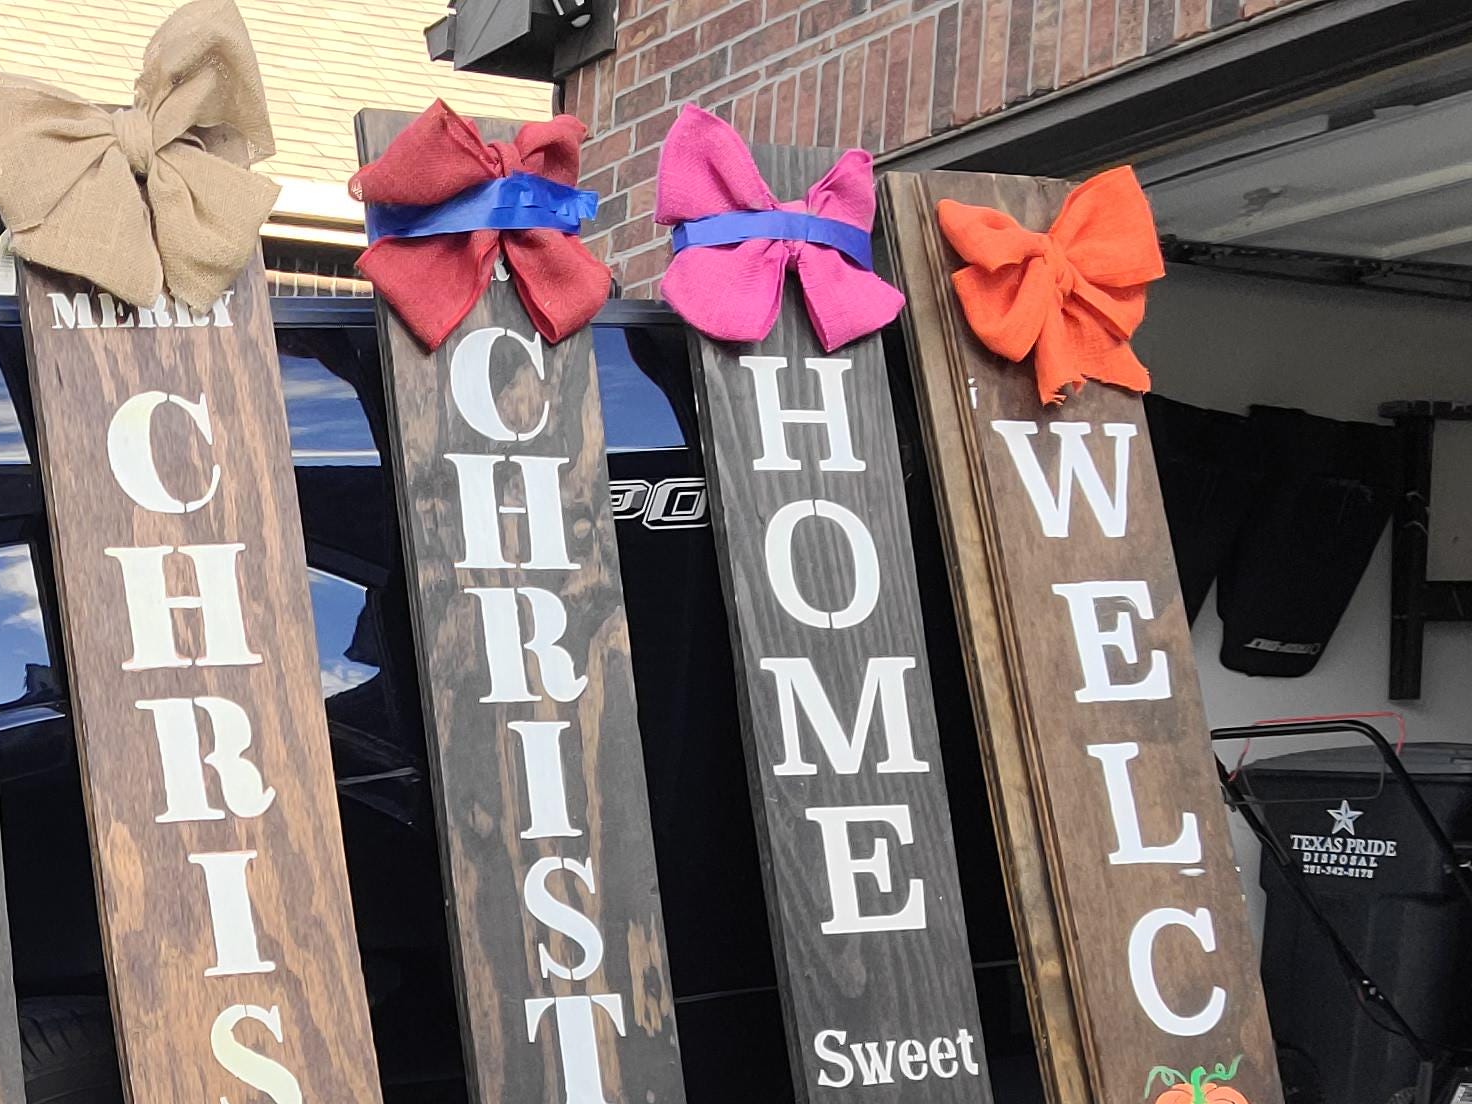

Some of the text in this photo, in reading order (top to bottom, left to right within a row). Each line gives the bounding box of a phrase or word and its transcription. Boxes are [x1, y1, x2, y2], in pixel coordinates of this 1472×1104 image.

[739, 355, 930, 935] HOME
[1290, 834, 1397, 856] TEXAS PRIDE
[1302, 852, 1378, 867] DISPOSAL
[813, 1028, 979, 1089] Sweet
